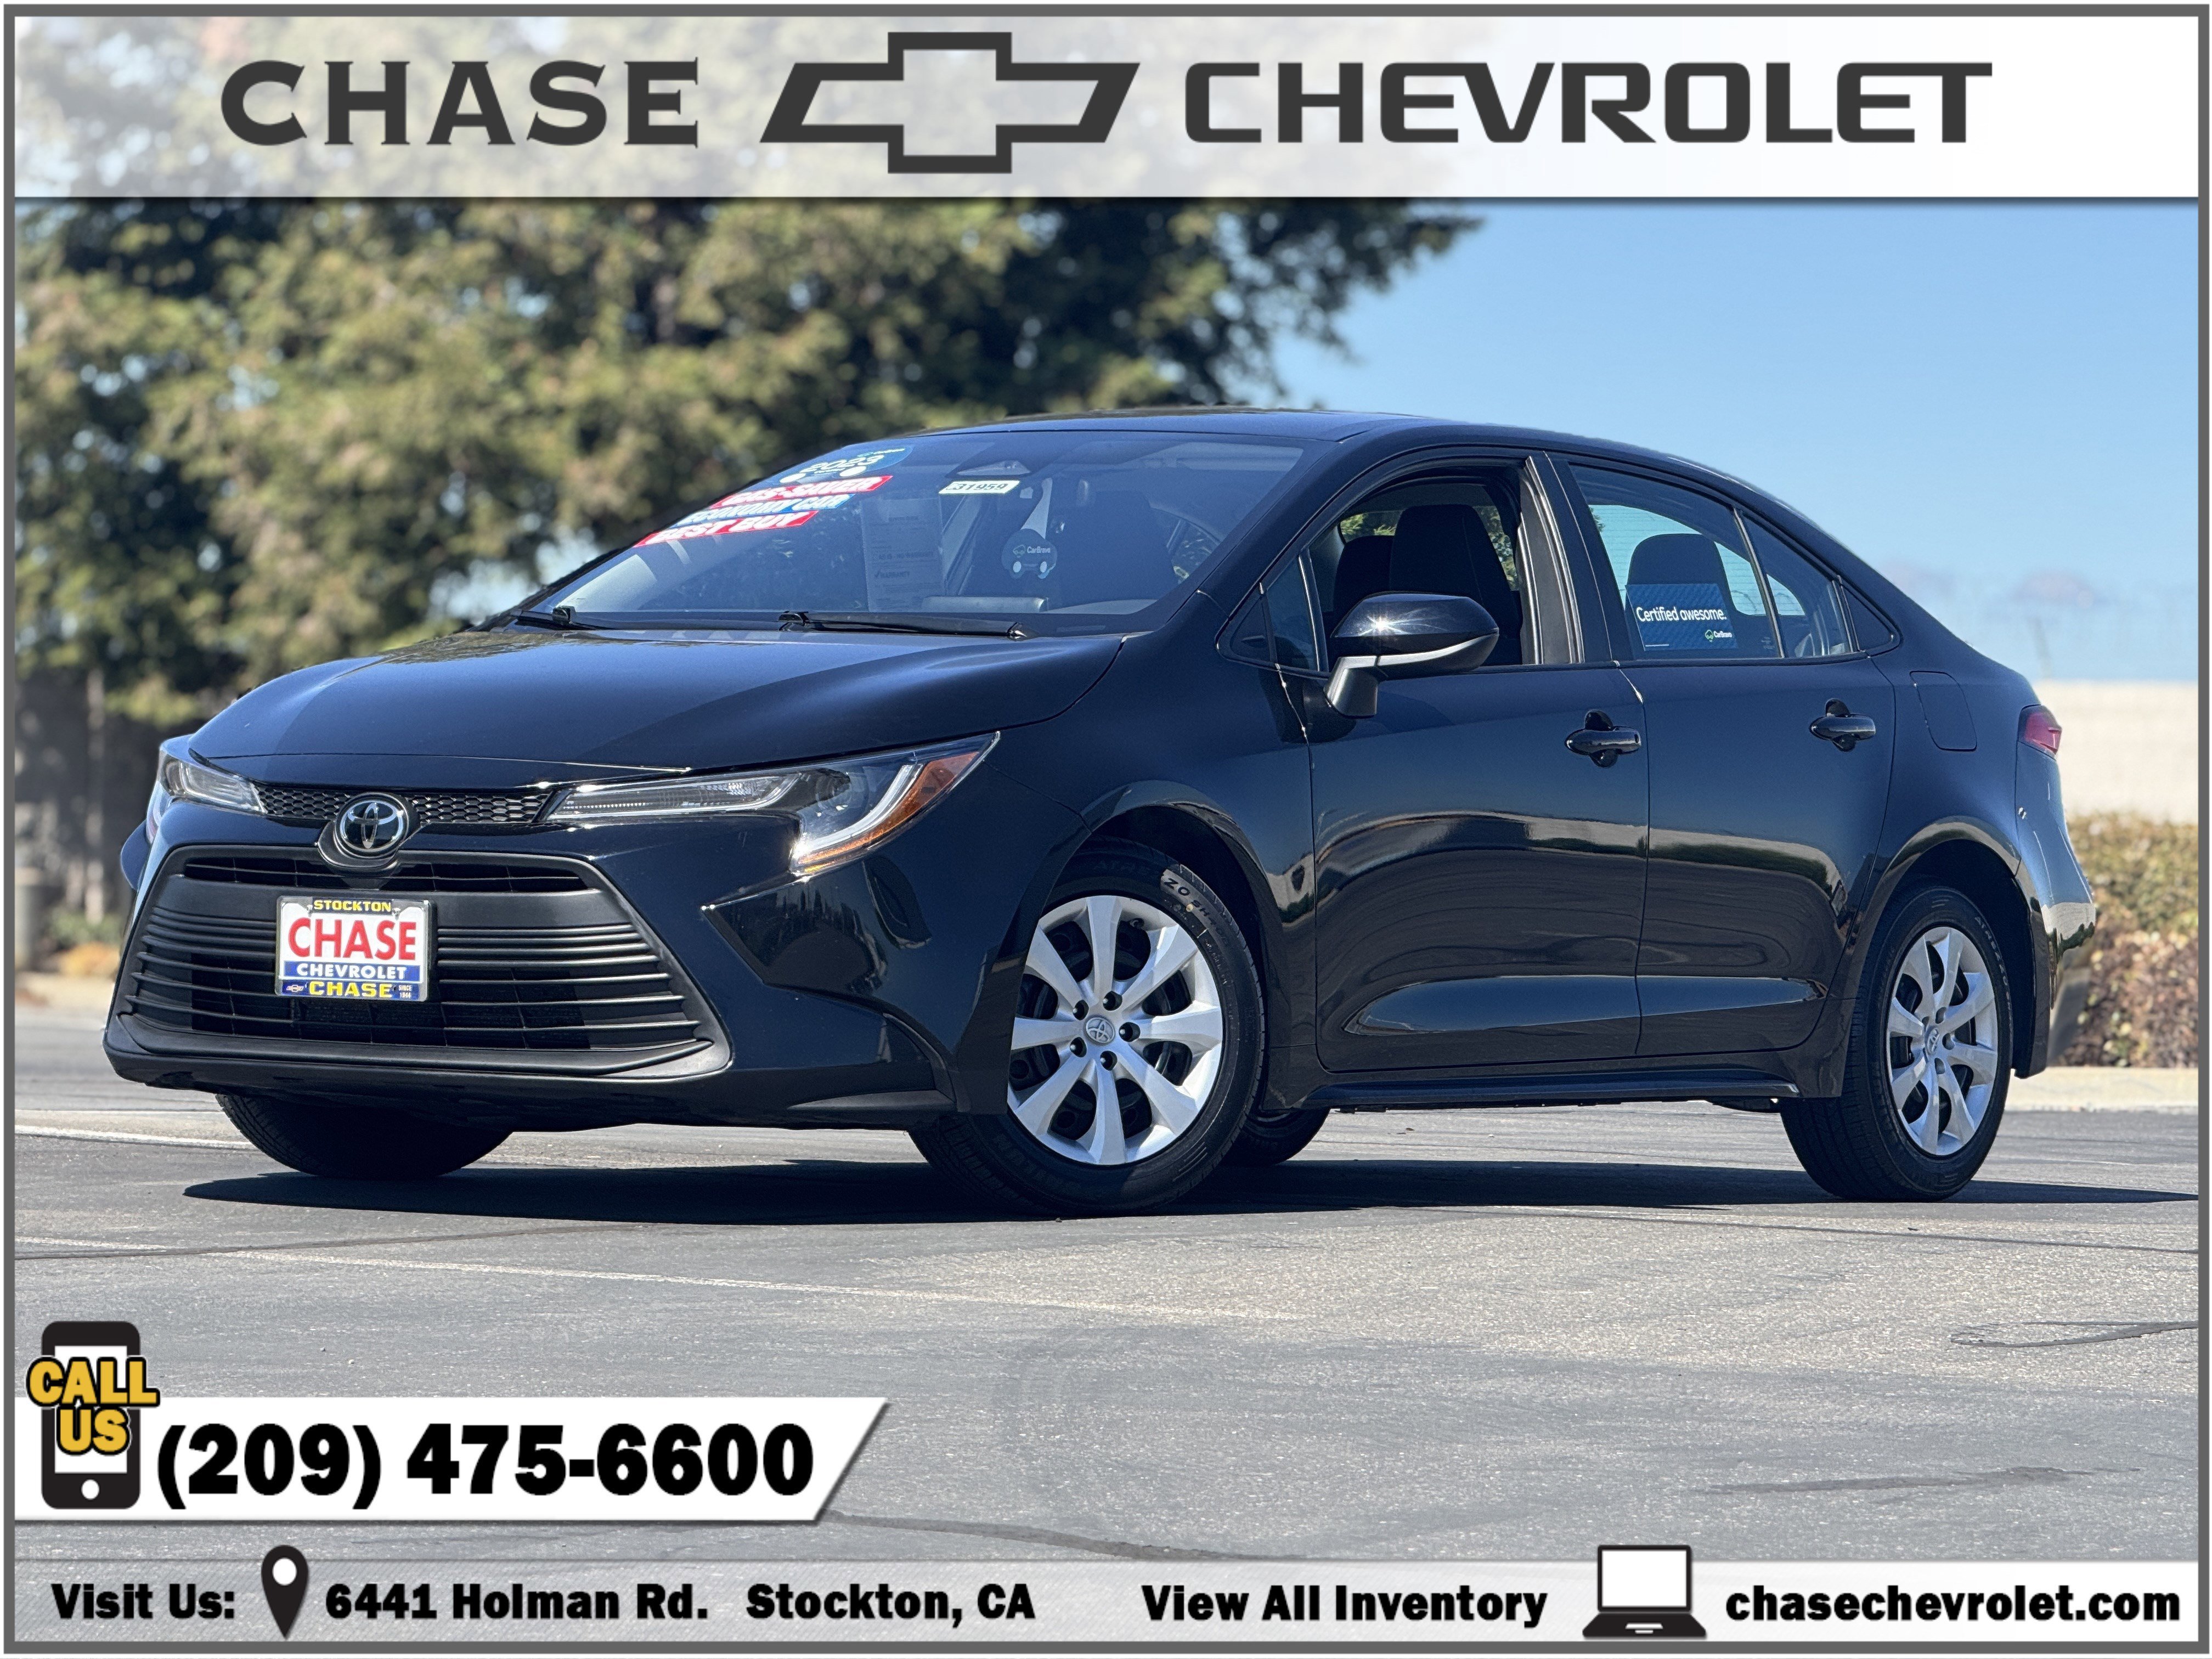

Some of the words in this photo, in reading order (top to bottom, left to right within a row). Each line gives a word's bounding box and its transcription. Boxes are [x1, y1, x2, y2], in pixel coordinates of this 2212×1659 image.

[799, 455, 884, 473] 2023
[792, 494, 850, 511] CAR
[645, 519, 737, 544] BEST
[729, 511, 810, 532] BUY
[1636, 606, 1679, 622] Certified
[1679, 608, 1727, 621] awesome.
[314, 900, 391, 912] STOCKTON
[288, 917, 416, 961] CHASE
[297, 963, 407, 979] CHEVROLET
[309, 981, 393, 998] CHASE
